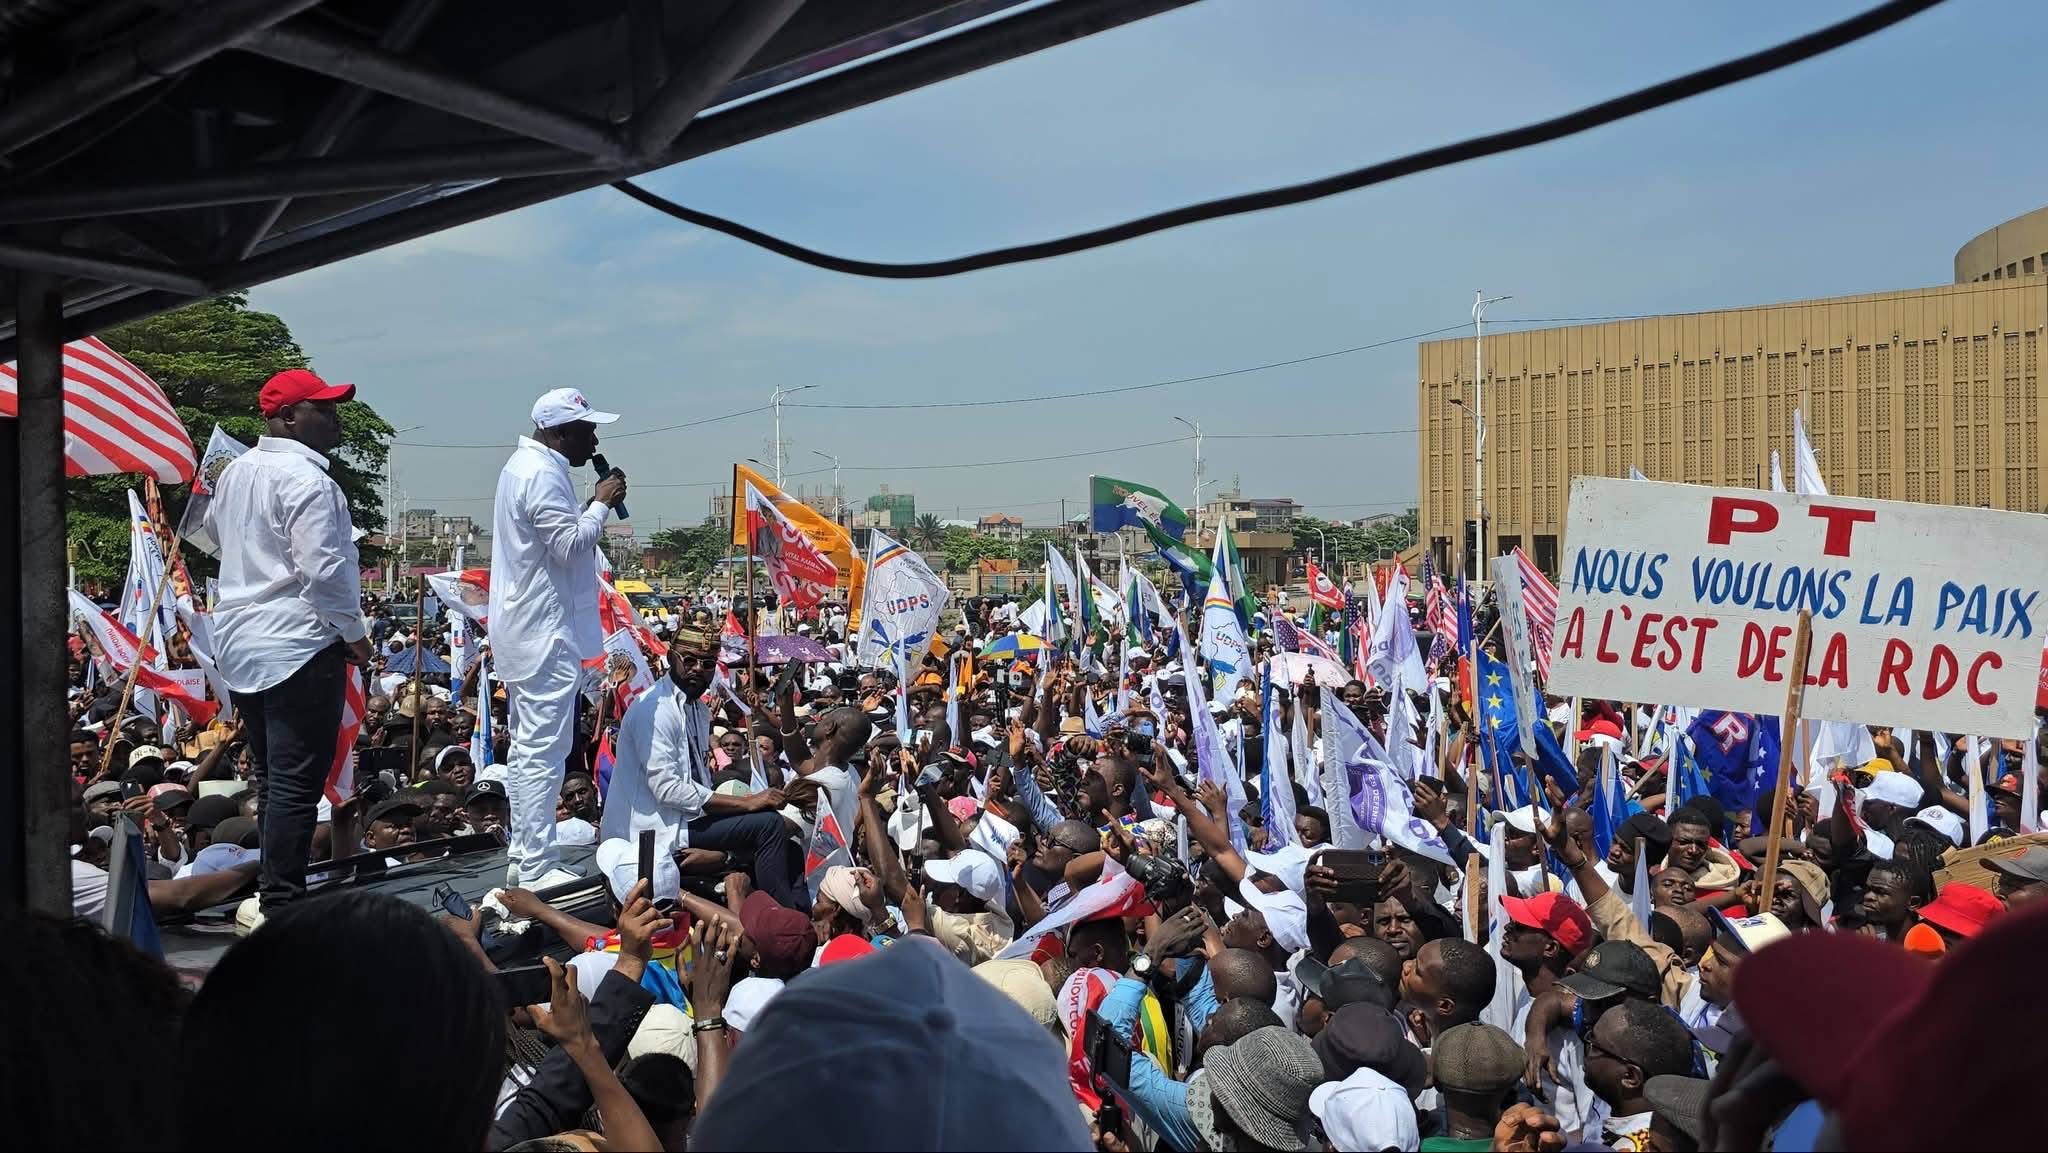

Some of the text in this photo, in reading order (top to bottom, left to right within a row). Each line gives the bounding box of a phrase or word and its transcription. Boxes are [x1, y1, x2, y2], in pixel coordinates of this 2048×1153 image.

[887, 594, 929, 615] UDPS
[1572, 546, 2039, 640] NOUS VOULONS LA PAIX
[1216, 631, 1242, 653] UDPS
[1560, 606, 1584, 658] A
[1596, 605, 1718, 674] L'EST
[1737, 622, 1793, 681] DE
[1803, 630, 1848, 689] LA
[1877, 637, 2003, 707] RDC
